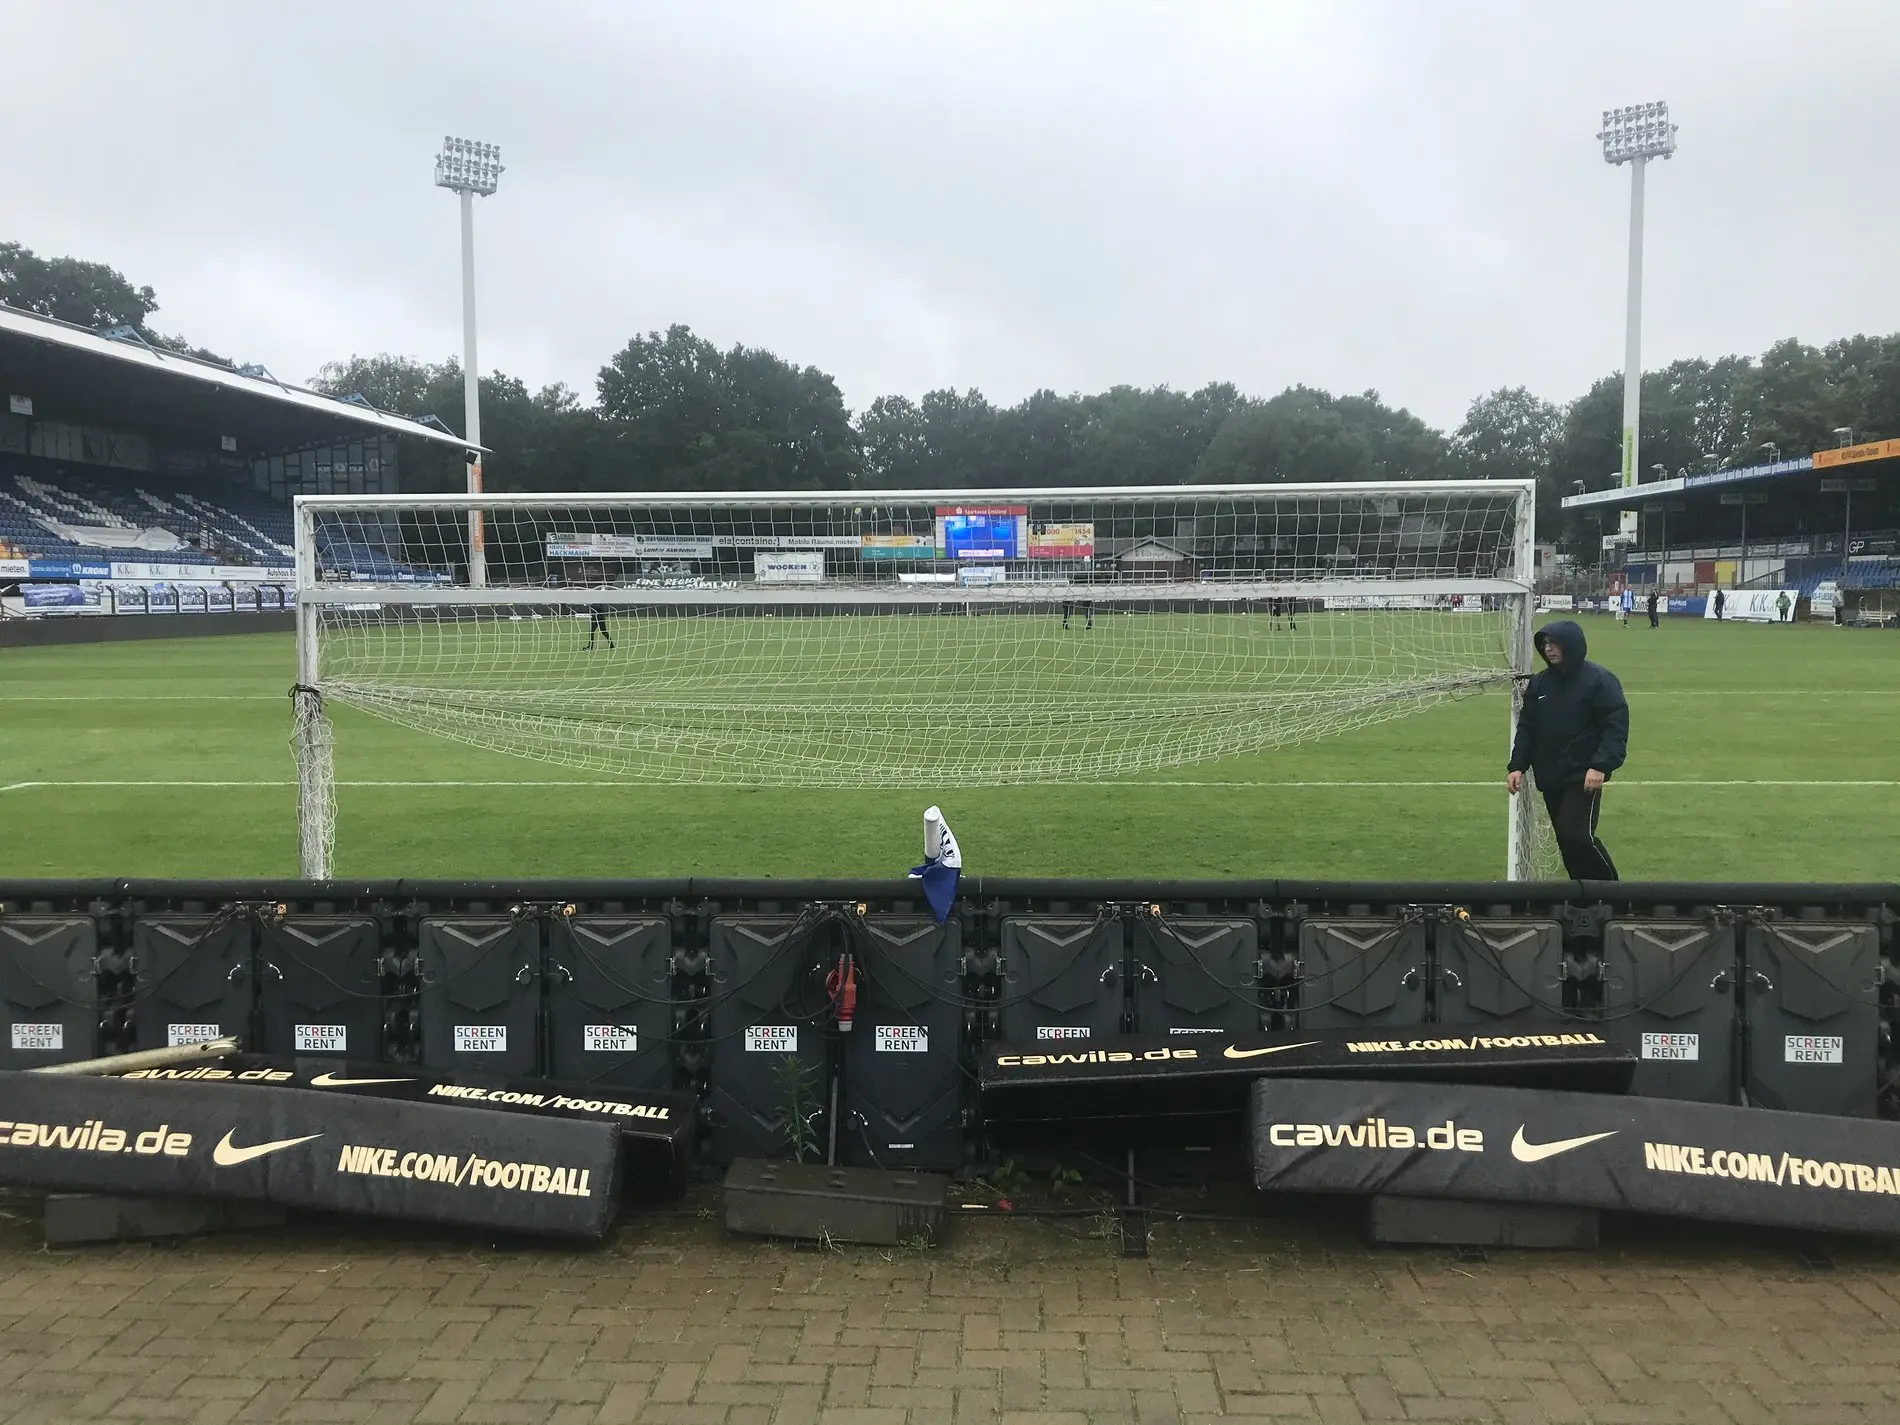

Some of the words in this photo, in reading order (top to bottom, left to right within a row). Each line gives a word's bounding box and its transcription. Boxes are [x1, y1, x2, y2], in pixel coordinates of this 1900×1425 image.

[1, 565, 27, 574] mieten.
[81, 567, 109, 576] KRONE
[13, 1026, 62, 1036] SCREEN
[170, 1025, 217, 1036] SCREEN
[296, 1026, 345, 1037] SCREEN
[456, 1027, 505, 1038] SCREEN
[586, 1027, 635, 1037] SCREEN
[746, 1027, 796, 1038] SCREEN
[877, 1027, 927, 1038] SCREEN
[1038, 1028, 1089, 1039] SCREEN
[21, 1038, 53, 1048] RENT
[304, 1038, 336, 1049] RENT
[464, 1039, 496, 1050] RENT
[594, 1039, 626, 1050] RENT
[754, 1039, 787, 1050] RENT
[885, 1039, 918, 1050] RENT
[1346, 1032, 1606, 1053] NIKE.COM/FOOTBALL
[1643, 1035, 1697, 1046] SCREEN
[1786, 1038, 1842, 1049] SCREEN
[996, 1047, 1198, 1066] cawila.de
[1652, 1047, 1687, 1058] RENT
[1795, 1050, 1832, 1061] RENT
[117, 1066, 294, 1081] awila.de
[427, 1084, 670, 1121] NIKE.COM/FOOTBALL
[1269, 1117, 1484, 1153] cawila.de
[337, 1144, 592, 1198] NIKE.COM/FOOTBALL
